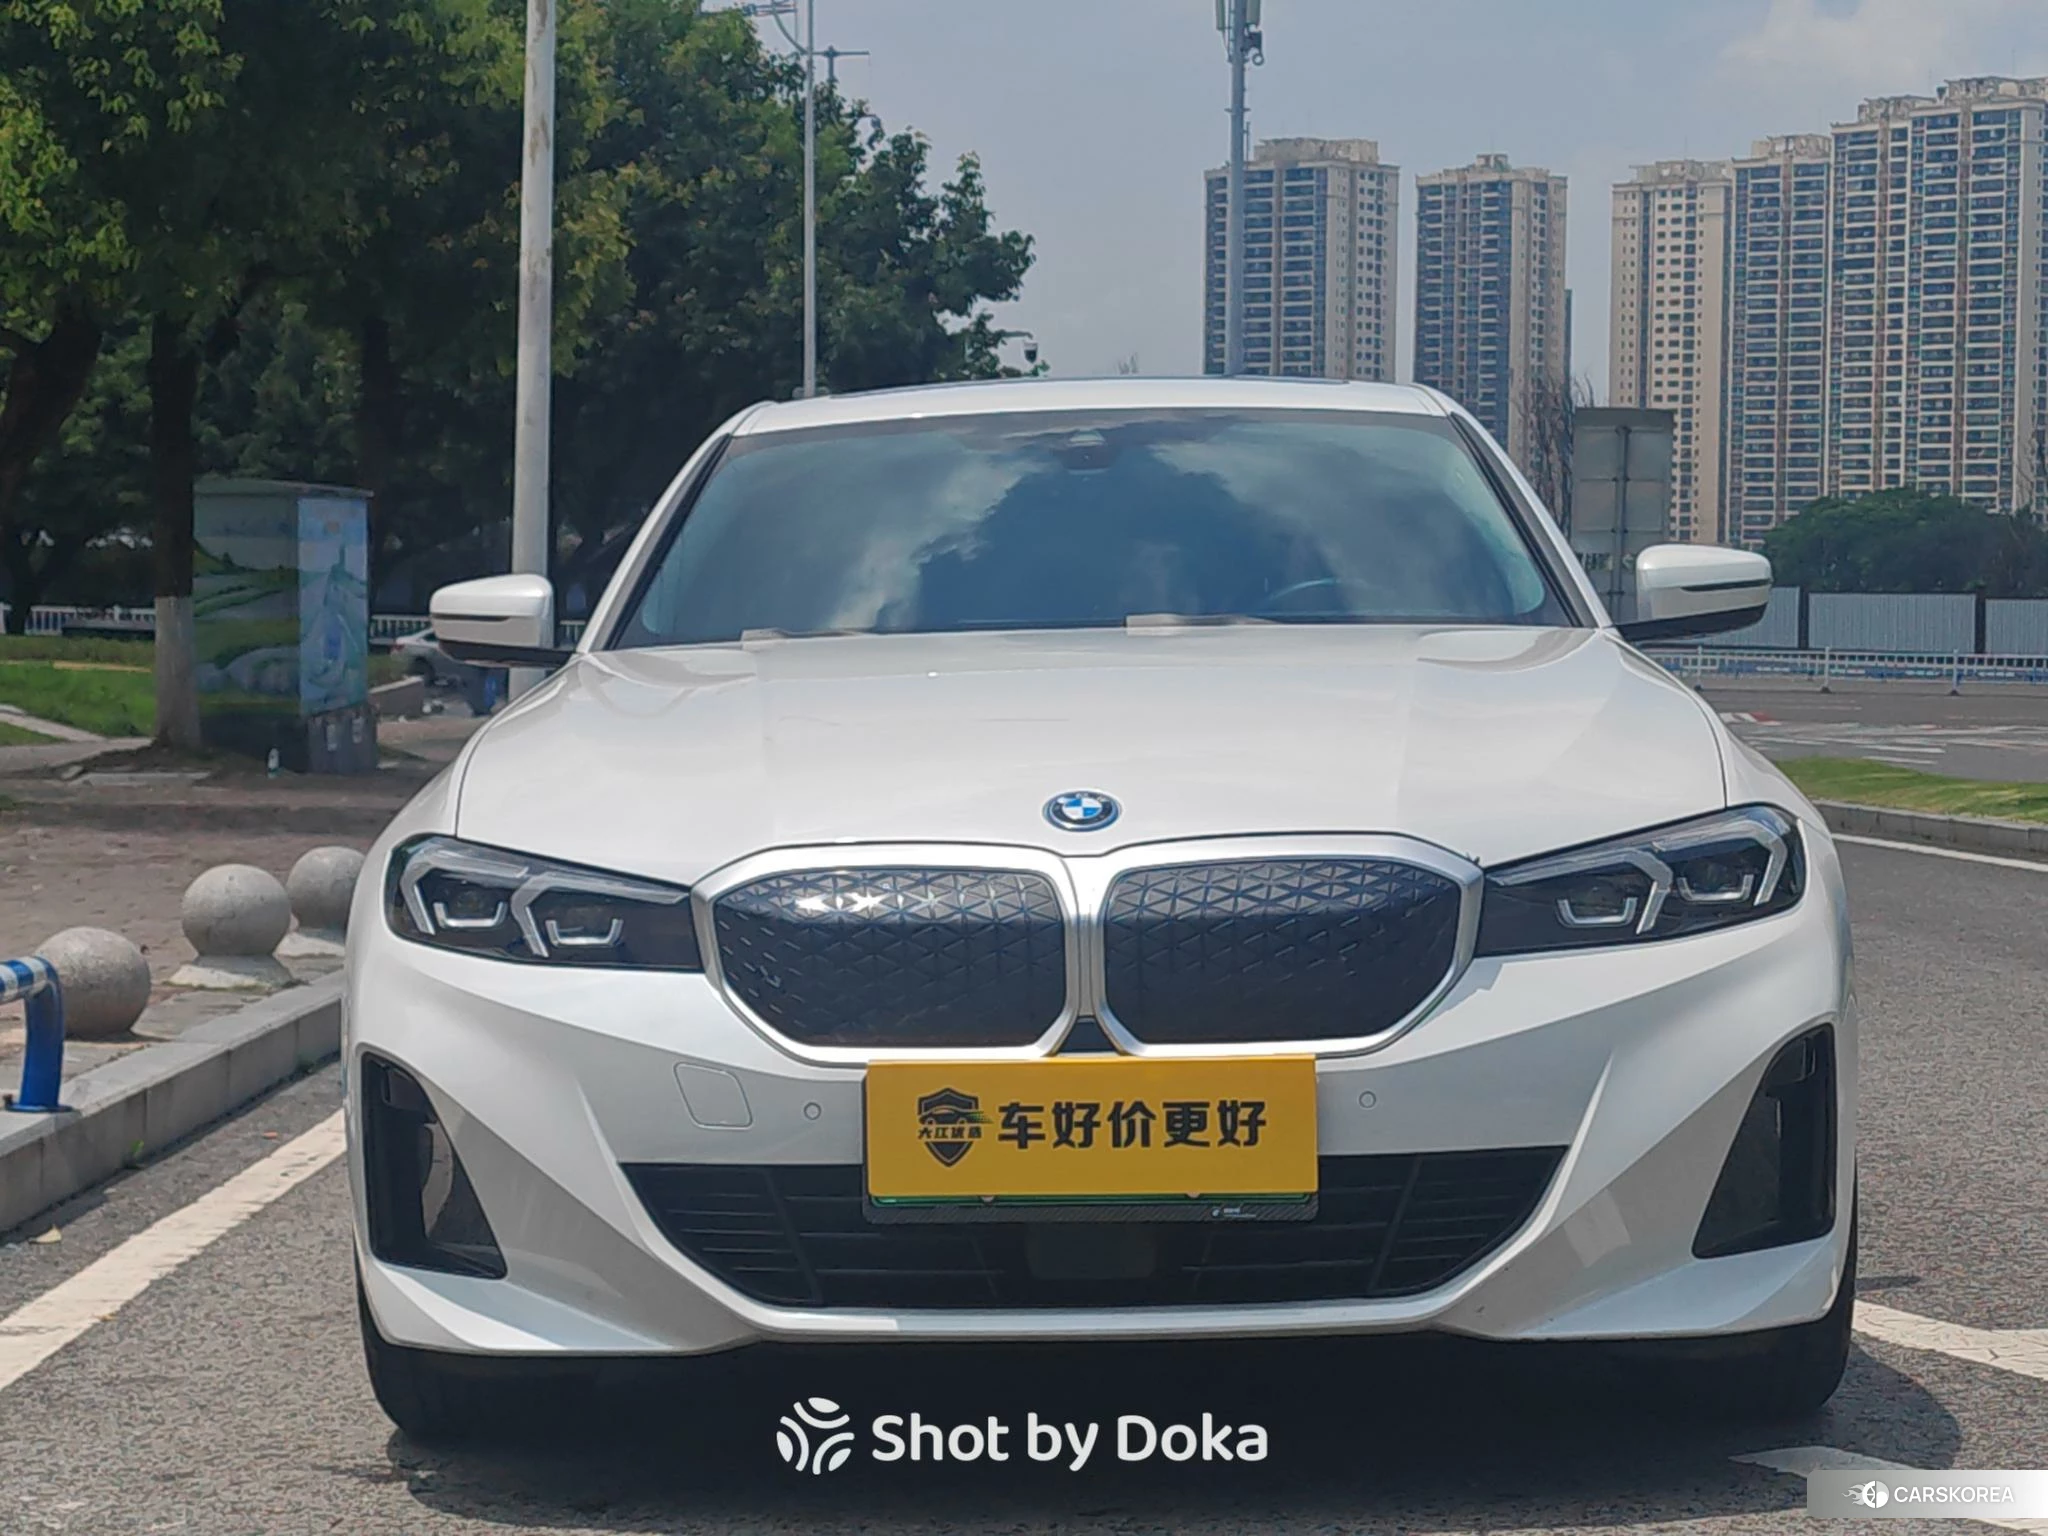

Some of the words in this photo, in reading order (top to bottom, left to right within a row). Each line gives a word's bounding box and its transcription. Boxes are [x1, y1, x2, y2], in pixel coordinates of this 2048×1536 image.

[998, 1100, 1267, 1150] 车好价更好
